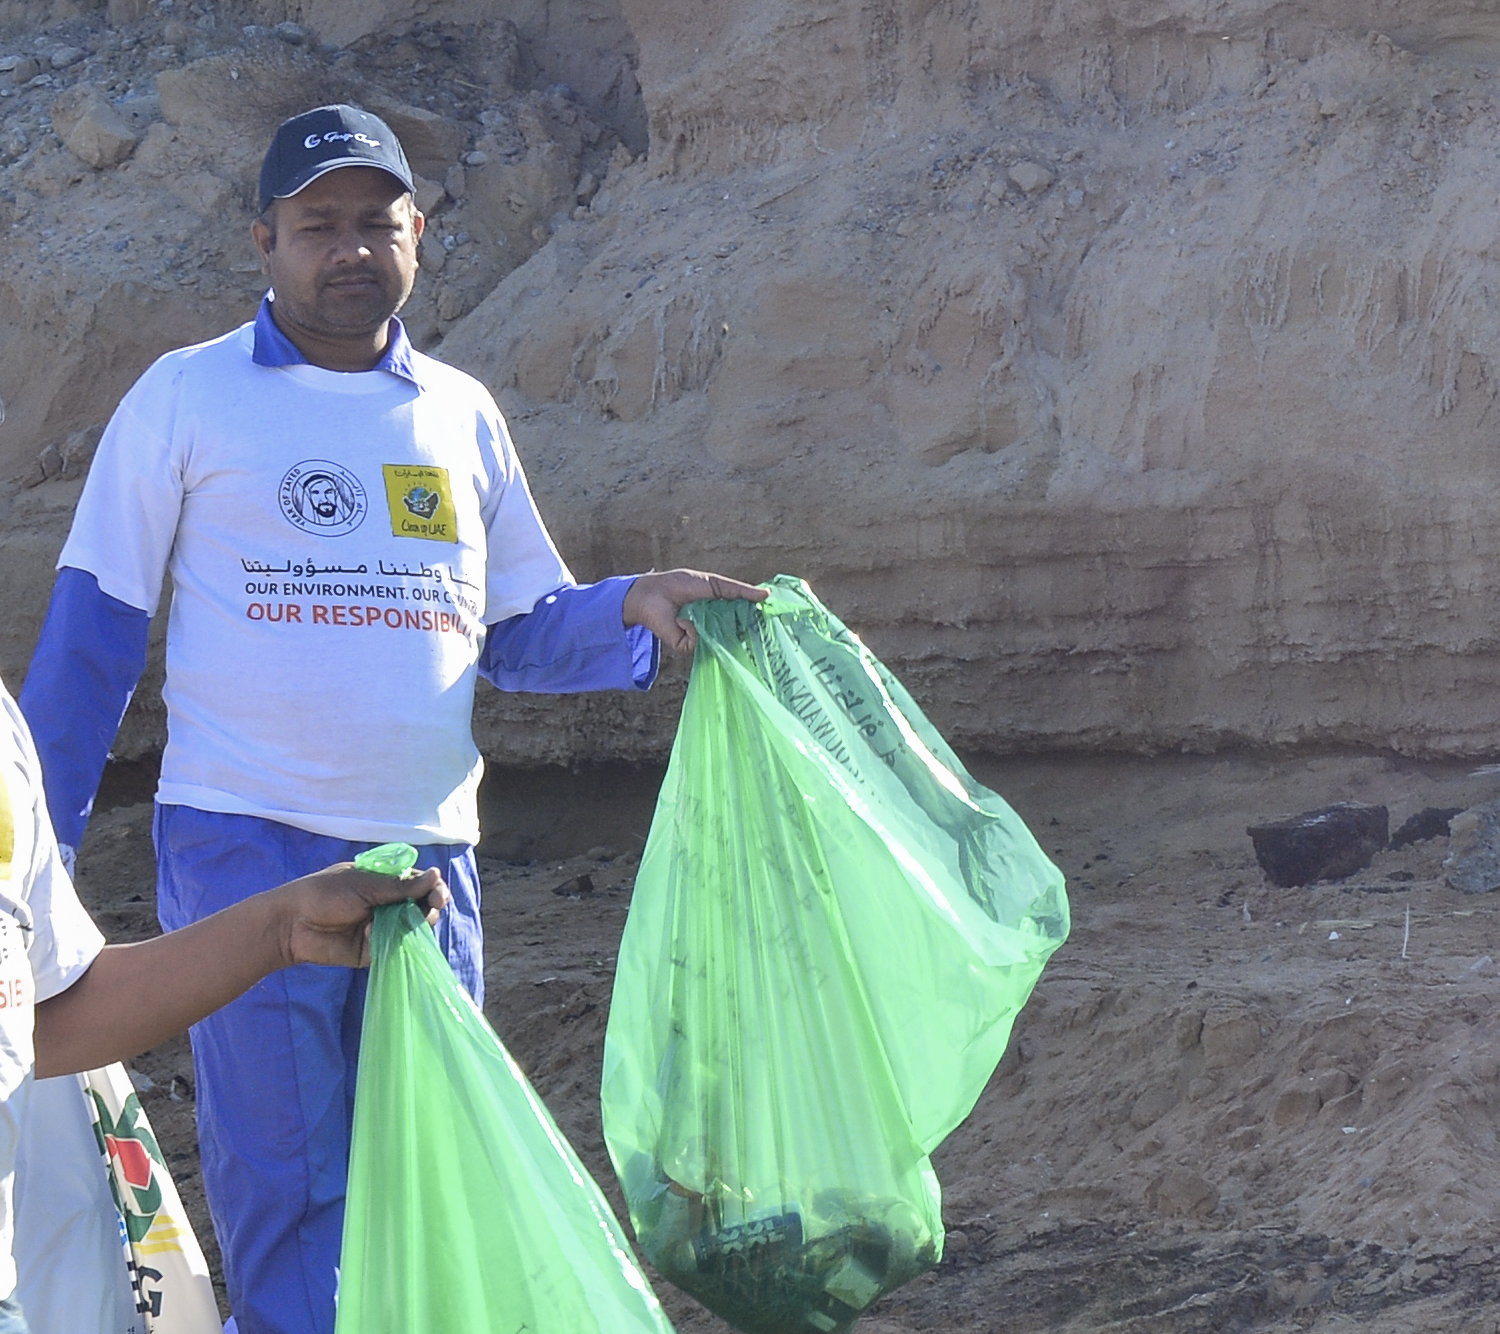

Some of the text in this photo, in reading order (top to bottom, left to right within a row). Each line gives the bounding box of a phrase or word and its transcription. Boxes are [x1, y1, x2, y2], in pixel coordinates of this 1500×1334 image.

[245, 582, 279, 595] OUR
[283, 582, 409, 600] ENVIRONMENT.
[412, 587, 441, 603] OUR
[246, 602, 303, 624] OUR
